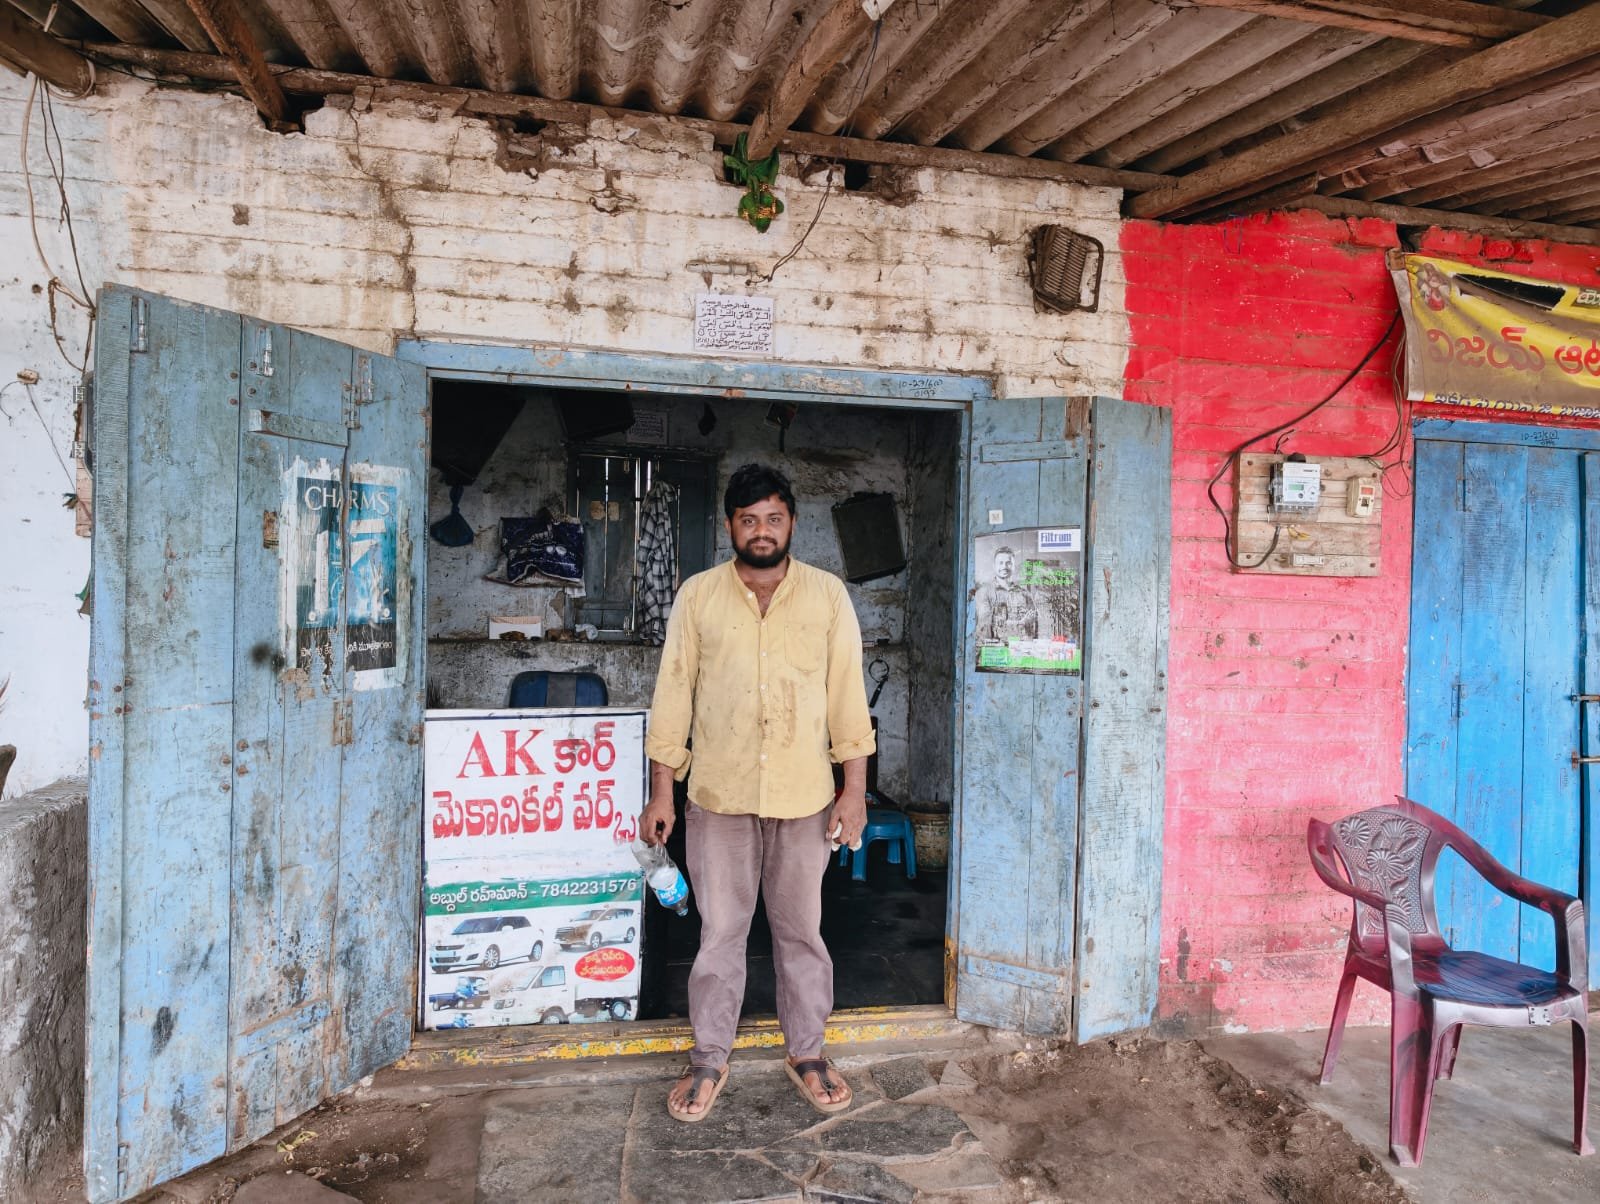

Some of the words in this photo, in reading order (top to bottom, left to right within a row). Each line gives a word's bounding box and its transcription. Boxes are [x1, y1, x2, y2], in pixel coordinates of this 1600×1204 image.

[1426, 327, 1546, 372] విజయ్
[304, 485, 390, 516] CHRMS
[455, 729, 546, 779] AK
[553, 721, 616, 775] కార్
[430, 887, 468, 912] అబ్దుల్
[540, 879, 638, 898] 7842231576
